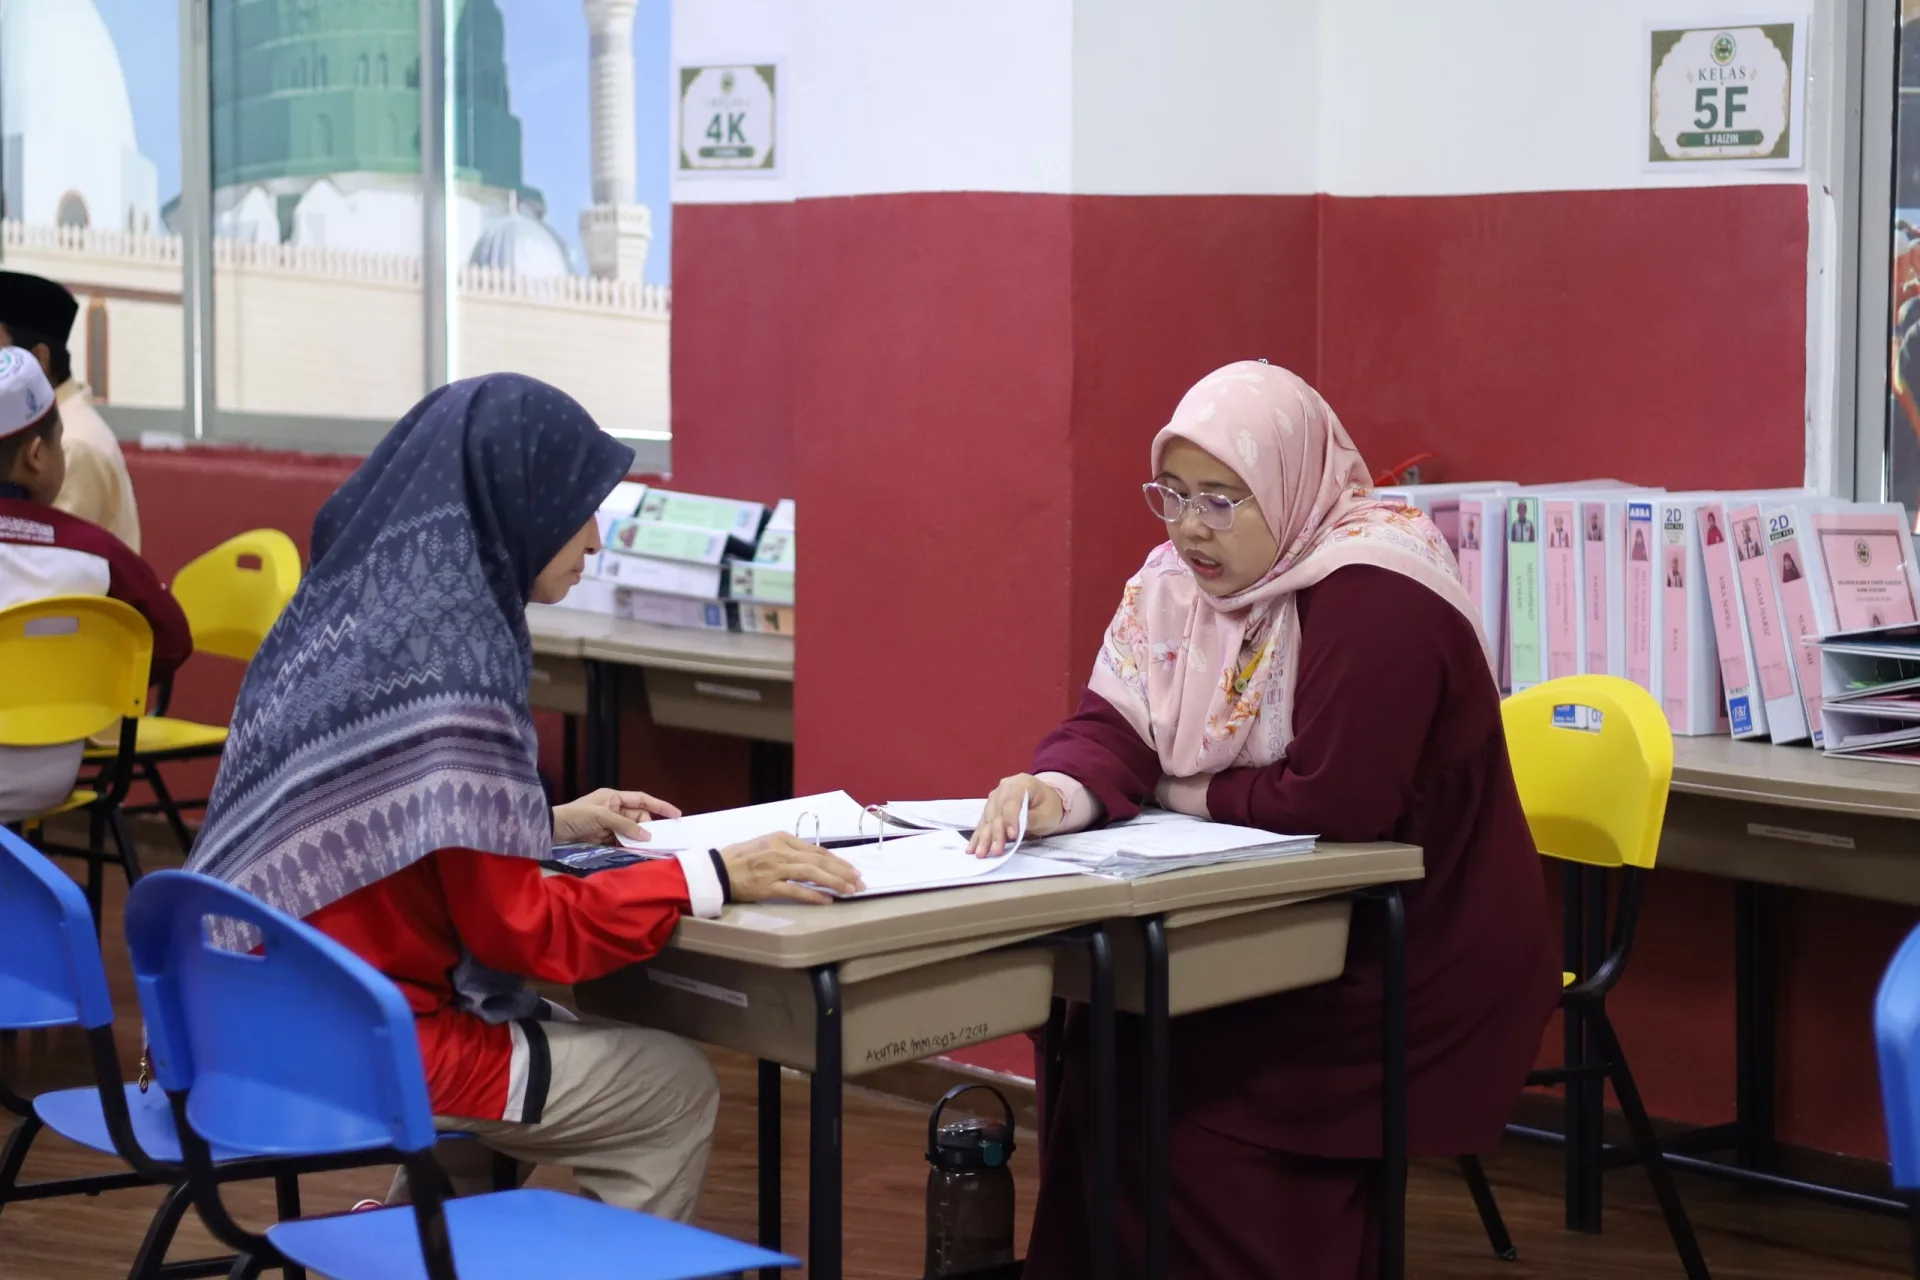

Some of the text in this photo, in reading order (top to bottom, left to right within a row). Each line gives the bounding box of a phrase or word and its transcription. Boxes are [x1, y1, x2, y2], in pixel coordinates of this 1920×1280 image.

[1698, 67, 1747, 82] KELAS
[1693, 86, 1749, 129] 5F
[705, 111, 747, 144] 4K
[1712, 132, 1739, 145] FAIZIN
[1666, 508, 1682, 522] 2D
[1769, 514, 1789, 532] 2D
[1753, 577, 1765, 604] ADAM
